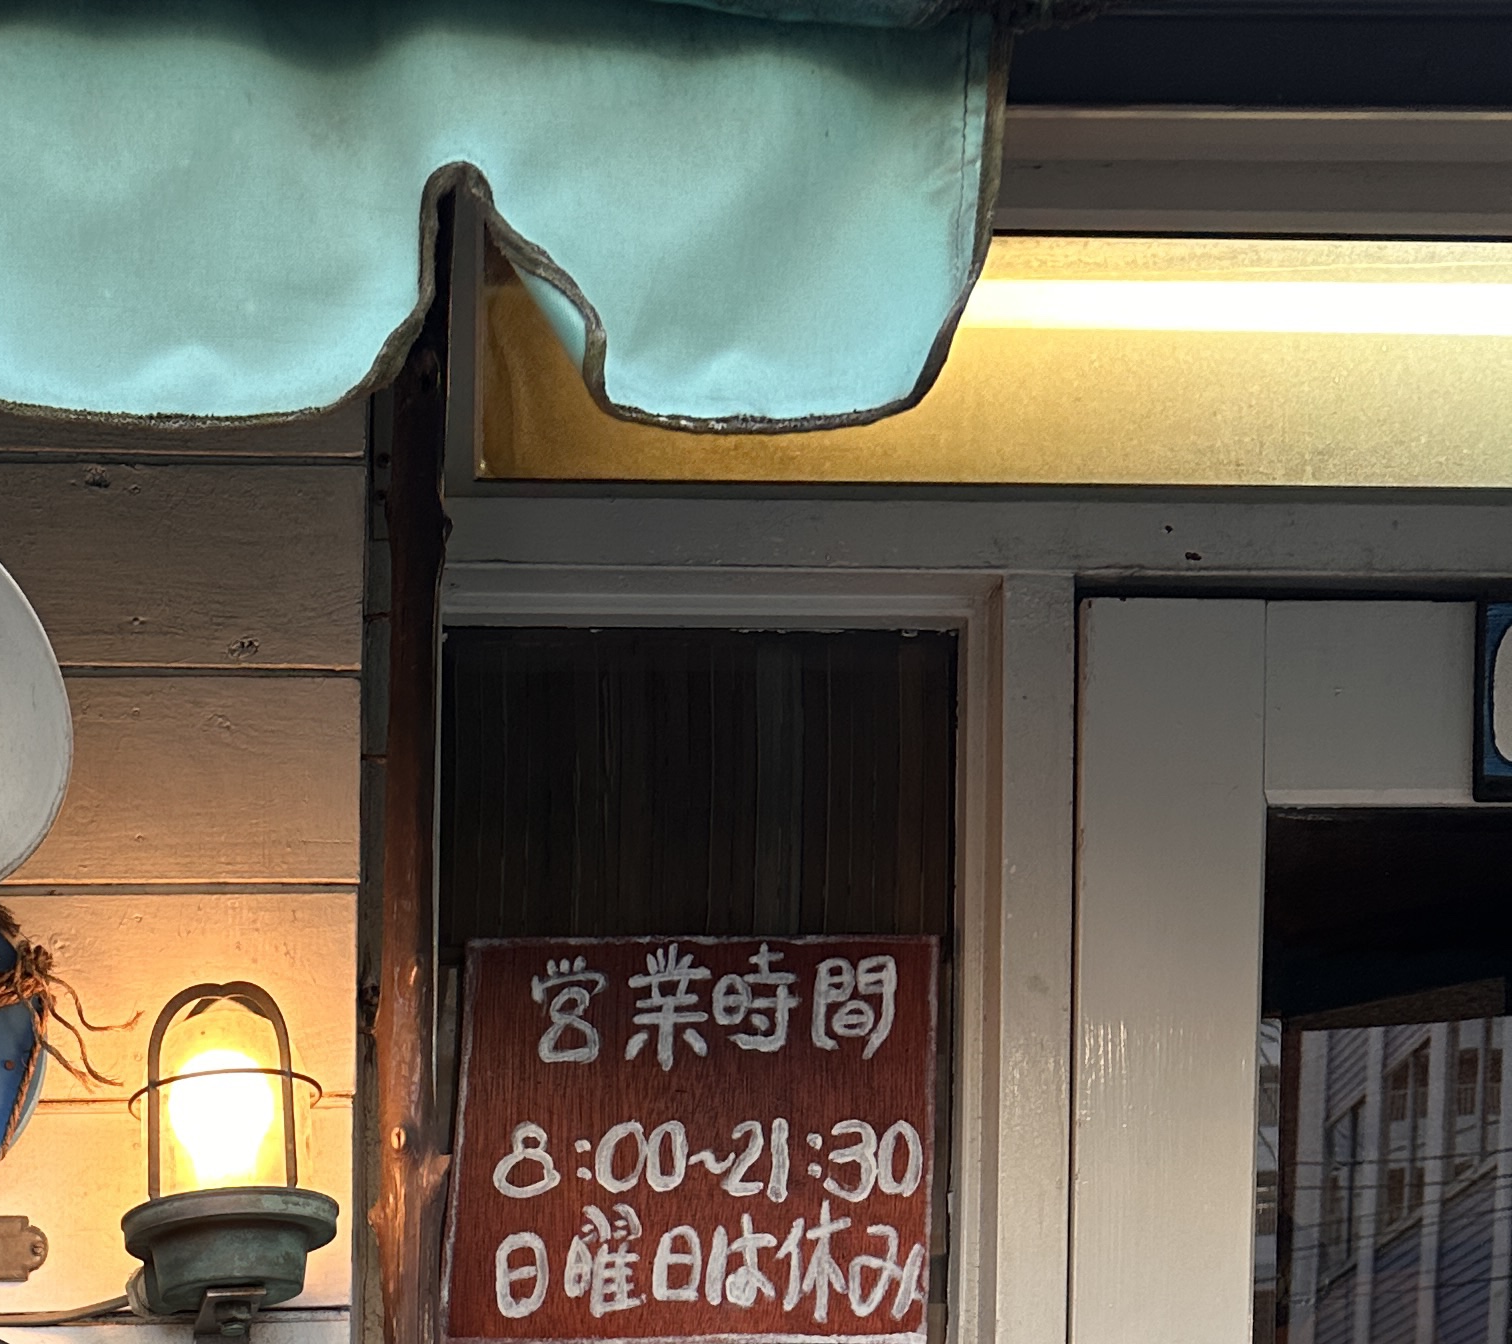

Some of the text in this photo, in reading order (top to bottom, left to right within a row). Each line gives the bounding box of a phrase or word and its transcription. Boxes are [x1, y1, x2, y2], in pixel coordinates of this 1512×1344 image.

[531, 942, 899, 1071] 営業時間
[495, 1200, 925, 1323] 日曜日は休み
